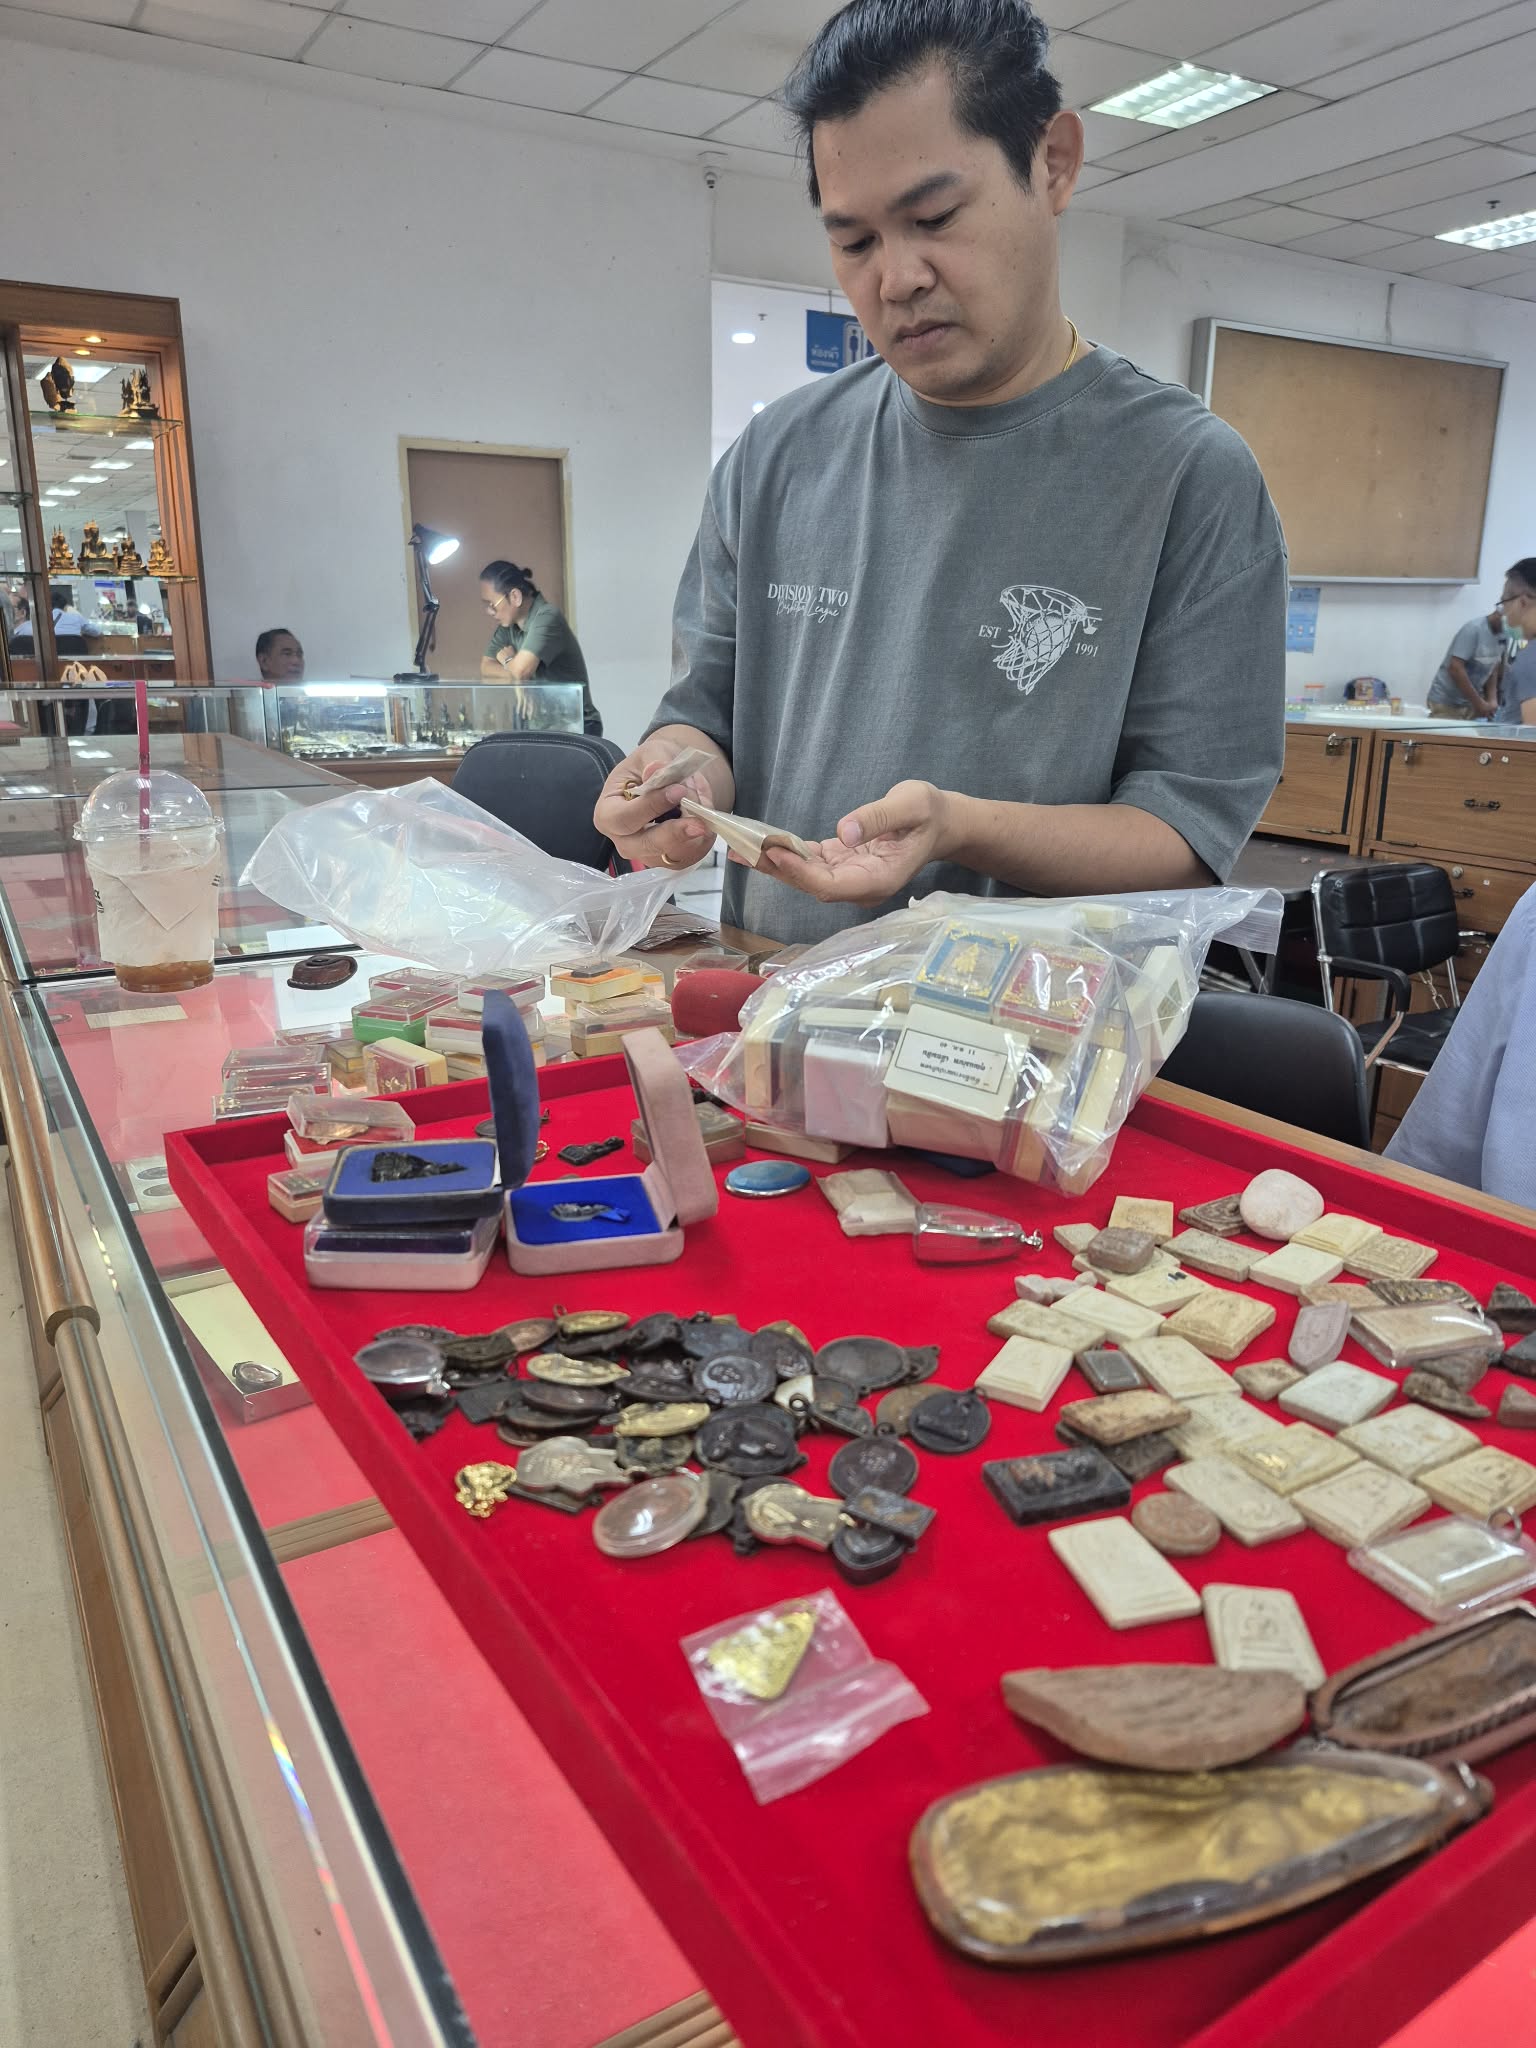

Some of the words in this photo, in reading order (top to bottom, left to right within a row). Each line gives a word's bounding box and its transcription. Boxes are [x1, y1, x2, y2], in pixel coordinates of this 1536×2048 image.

[818, 586, 849, 607] TWO
[978, 625, 1002, 639] EST
[1075, 643, 1099, 657] 1991
